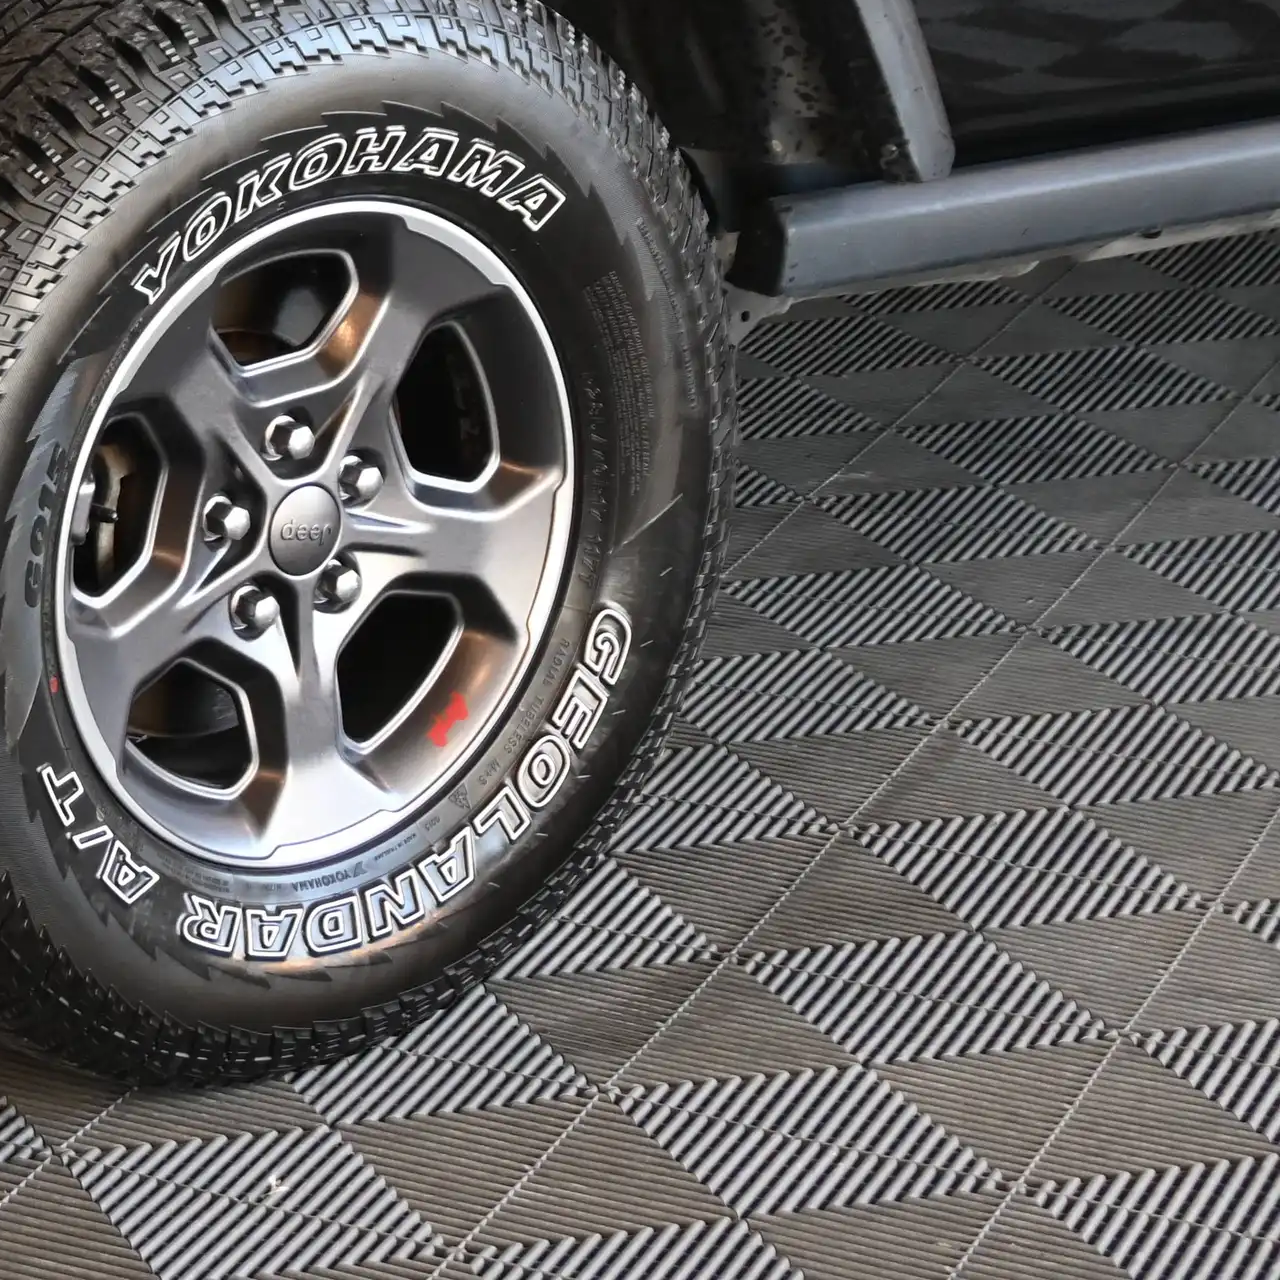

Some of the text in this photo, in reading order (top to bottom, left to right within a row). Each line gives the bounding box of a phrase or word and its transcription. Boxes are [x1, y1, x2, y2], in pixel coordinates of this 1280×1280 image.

[131, 125, 567, 305] YOKOHAMA
[281, 516, 332, 547] Jeep
[543, 637, 571, 687] RADIAL
[503, 695, 544, 754] TUBELESS
[38, 604, 632, 961] GEOLANDAR A/T
[291, 869, 352, 893] YOKOHAMA
